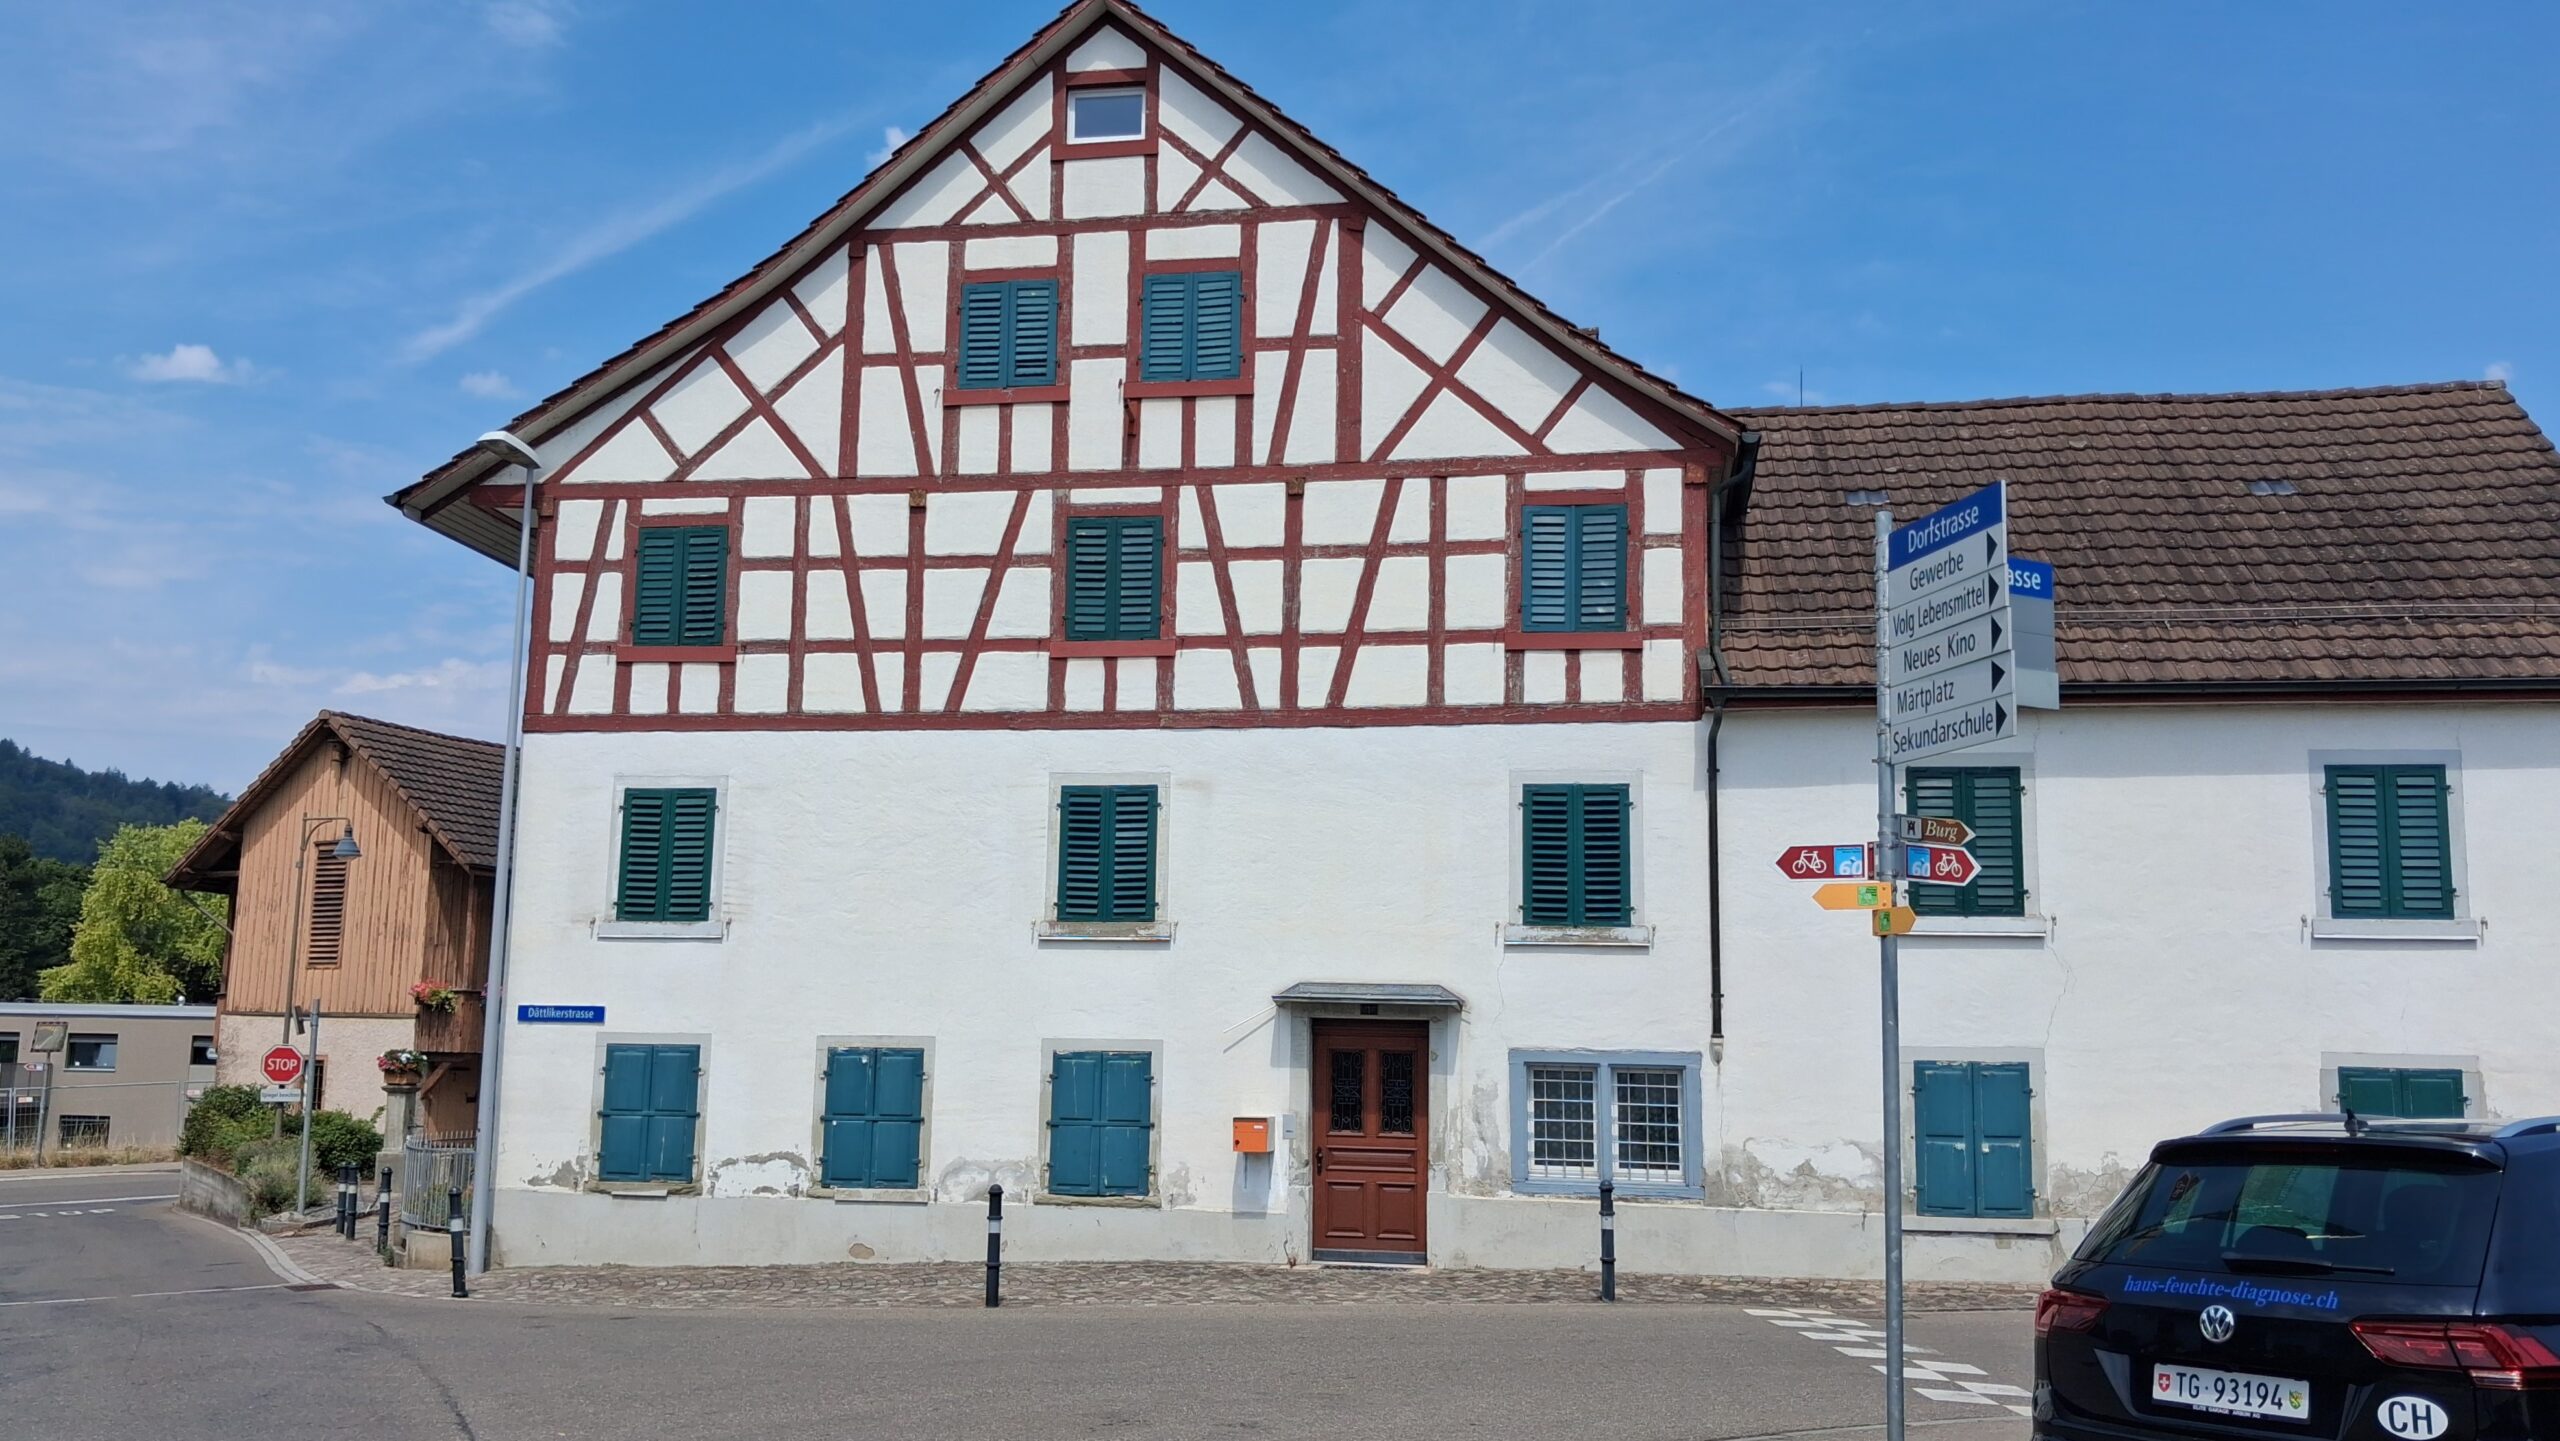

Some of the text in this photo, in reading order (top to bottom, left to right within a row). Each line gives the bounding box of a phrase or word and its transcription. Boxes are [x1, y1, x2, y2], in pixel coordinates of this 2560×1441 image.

[1908, 505, 1979, 553] Dorfstrasse
[1910, 551, 1964, 591] Gewerbe
[1893, 582, 1985, 638] Volg Lebensmittel
[1904, 632, 1976, 673] Neues Kino
[1897, 680, 1955, 715] Märtplatz
[1893, 707, 1993, 755] Sekundarschule
[1925, 820, 1958, 842] Burg
[1839, 860, 1862, 876] 60
[1912, 861, 1930, 877] 60
[528, 1007, 594, 1019] Dättlikerstrasse
[267, 1058, 298, 1071] STOP
[2124, 1275, 2338, 1309] haus-feuchte-diagnose.ch
[2388, 1400, 2433, 1436] CH
